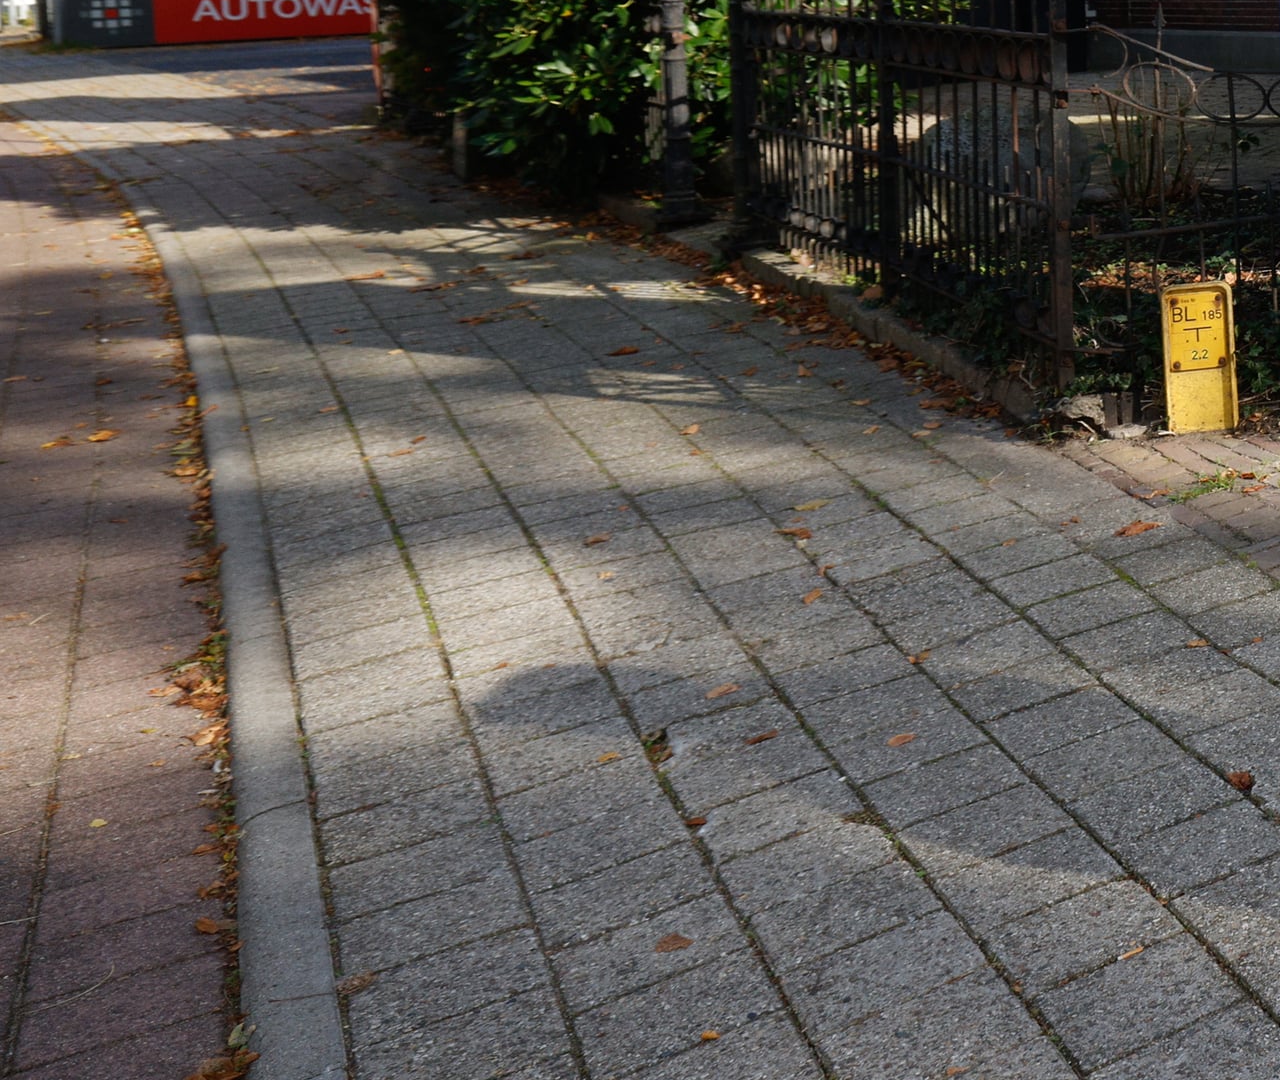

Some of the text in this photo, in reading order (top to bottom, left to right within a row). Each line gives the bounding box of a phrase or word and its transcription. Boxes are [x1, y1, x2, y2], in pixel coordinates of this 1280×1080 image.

[1172, 307, 1222, 323] BL 185
[1192, 349, 1208, 361] 2.2
